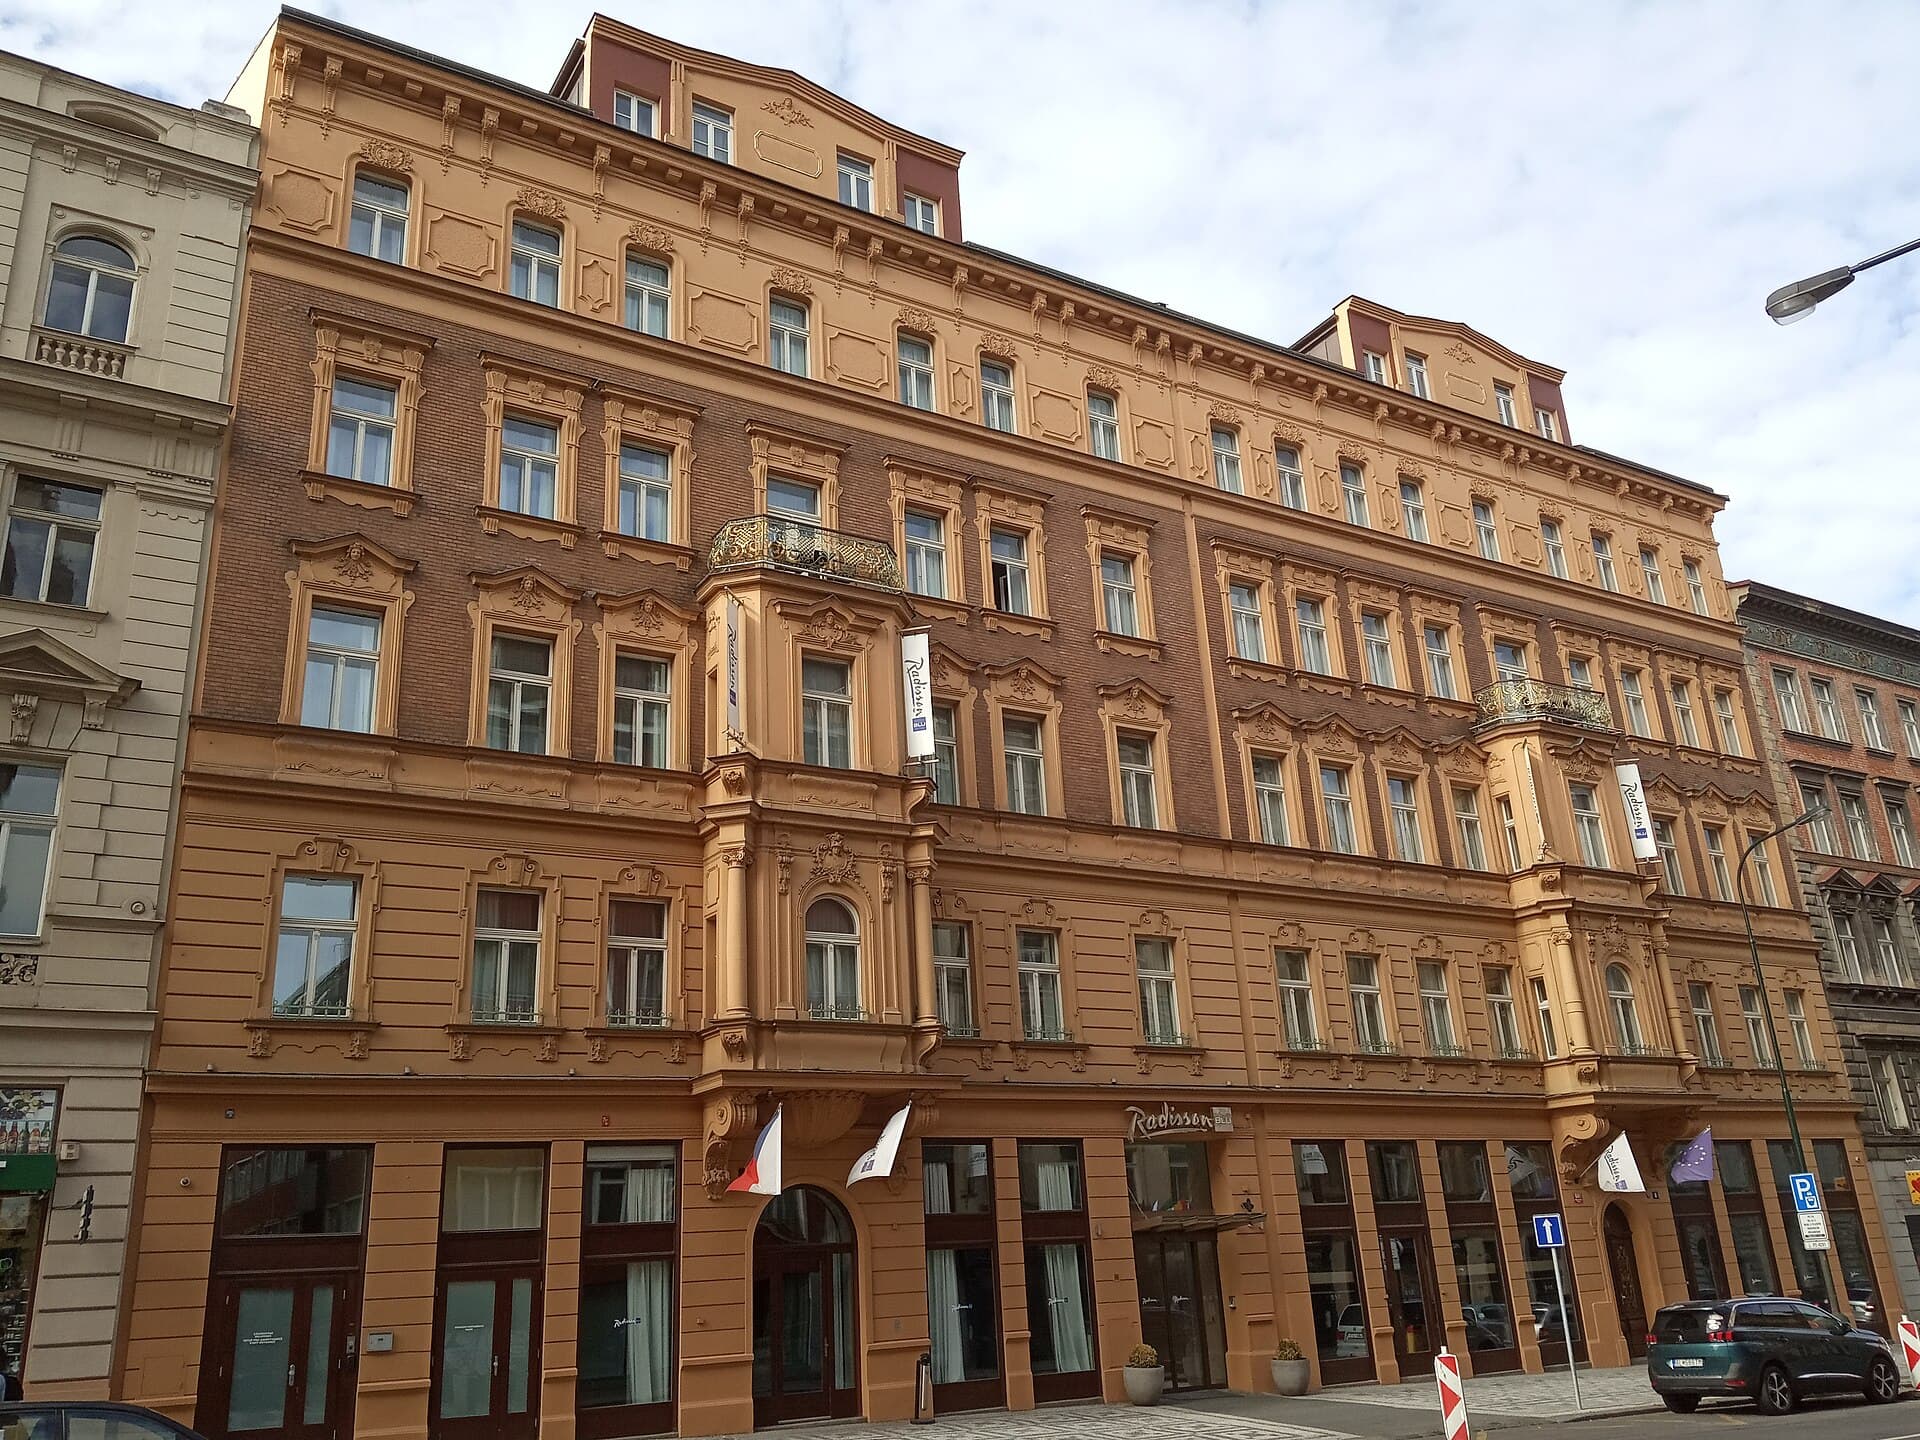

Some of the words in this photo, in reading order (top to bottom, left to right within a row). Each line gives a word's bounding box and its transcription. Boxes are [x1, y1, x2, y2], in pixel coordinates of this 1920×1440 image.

[904, 656, 928, 717] Radisson
[1620, 782, 1644, 828] Radisson
[1124, 1101, 1214, 1143] Radisson
[1795, 1178, 1811, 1200] P
